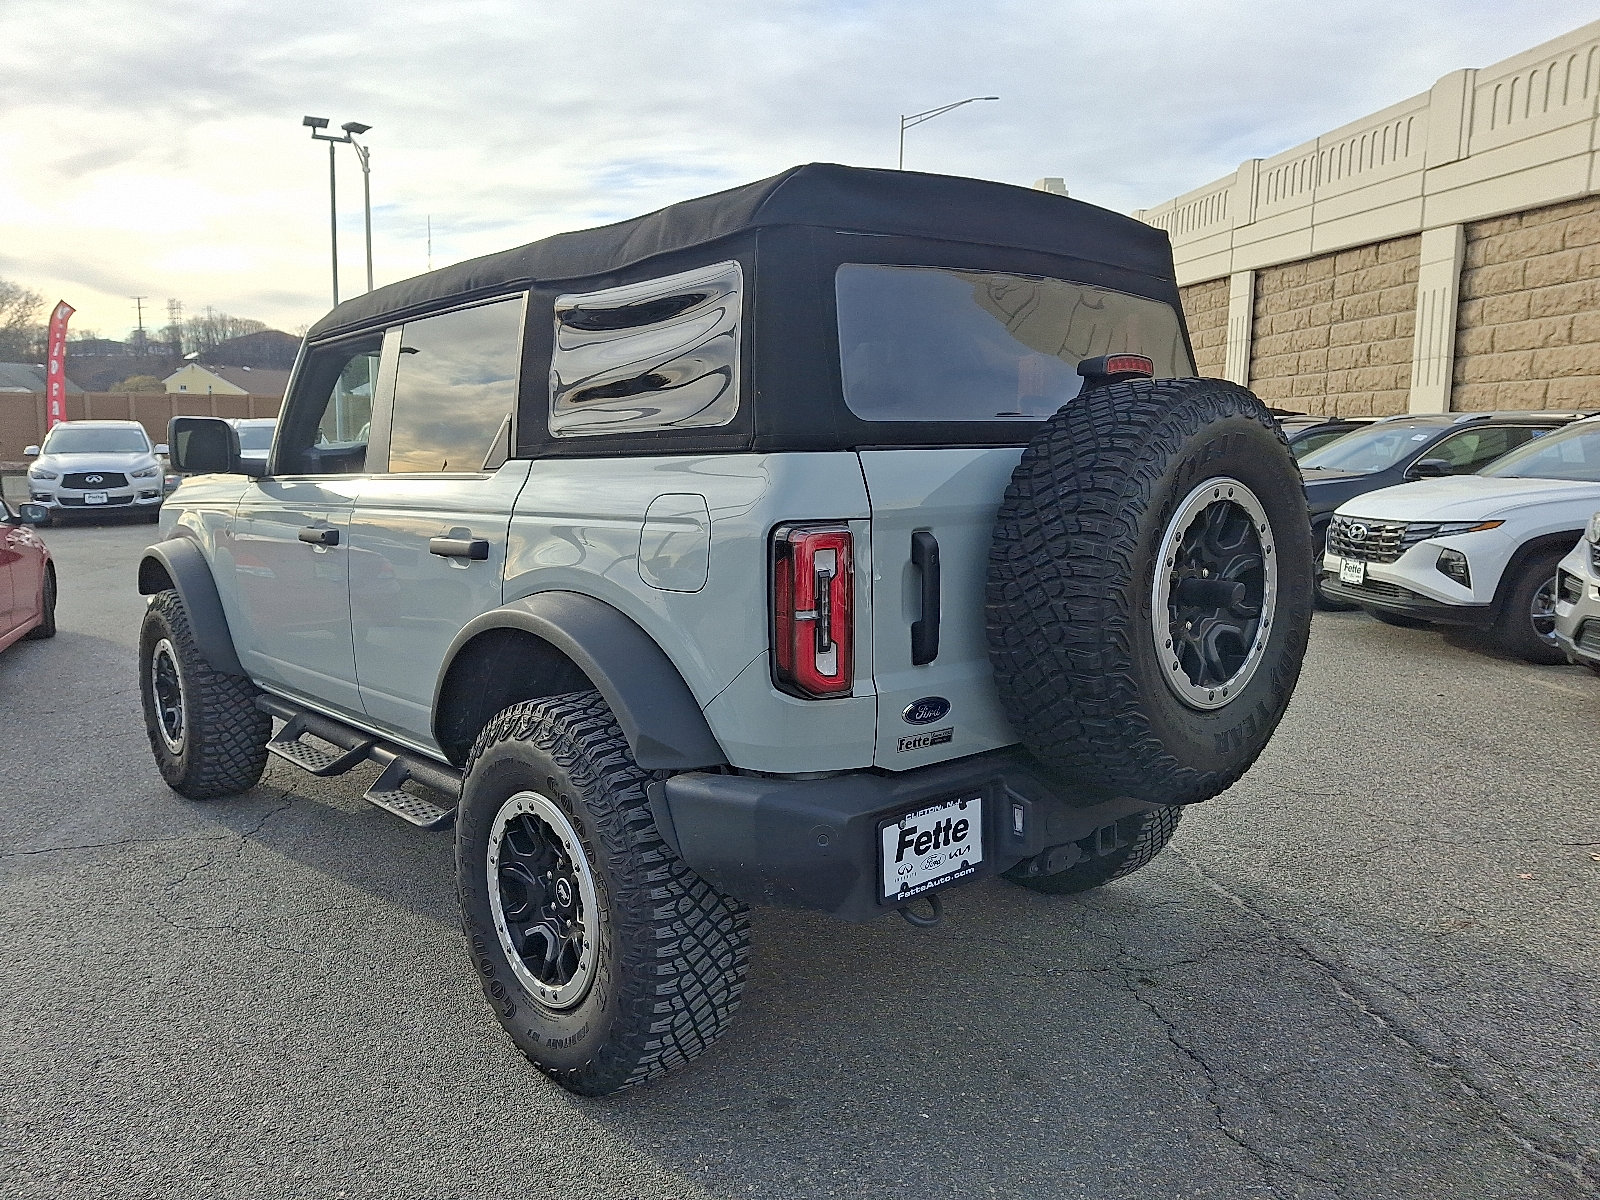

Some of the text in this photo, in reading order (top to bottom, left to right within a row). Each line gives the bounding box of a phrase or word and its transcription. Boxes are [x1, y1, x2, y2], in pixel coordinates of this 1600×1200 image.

[1343, 562, 1362, 574] Fette
[915, 704, 941, 720] Ford
[898, 736, 930, 751] Fette
[895, 816, 970, 864] Fette
[924, 854, 942, 870] Ford
[897, 867, 975, 901] FetteAuto.com
